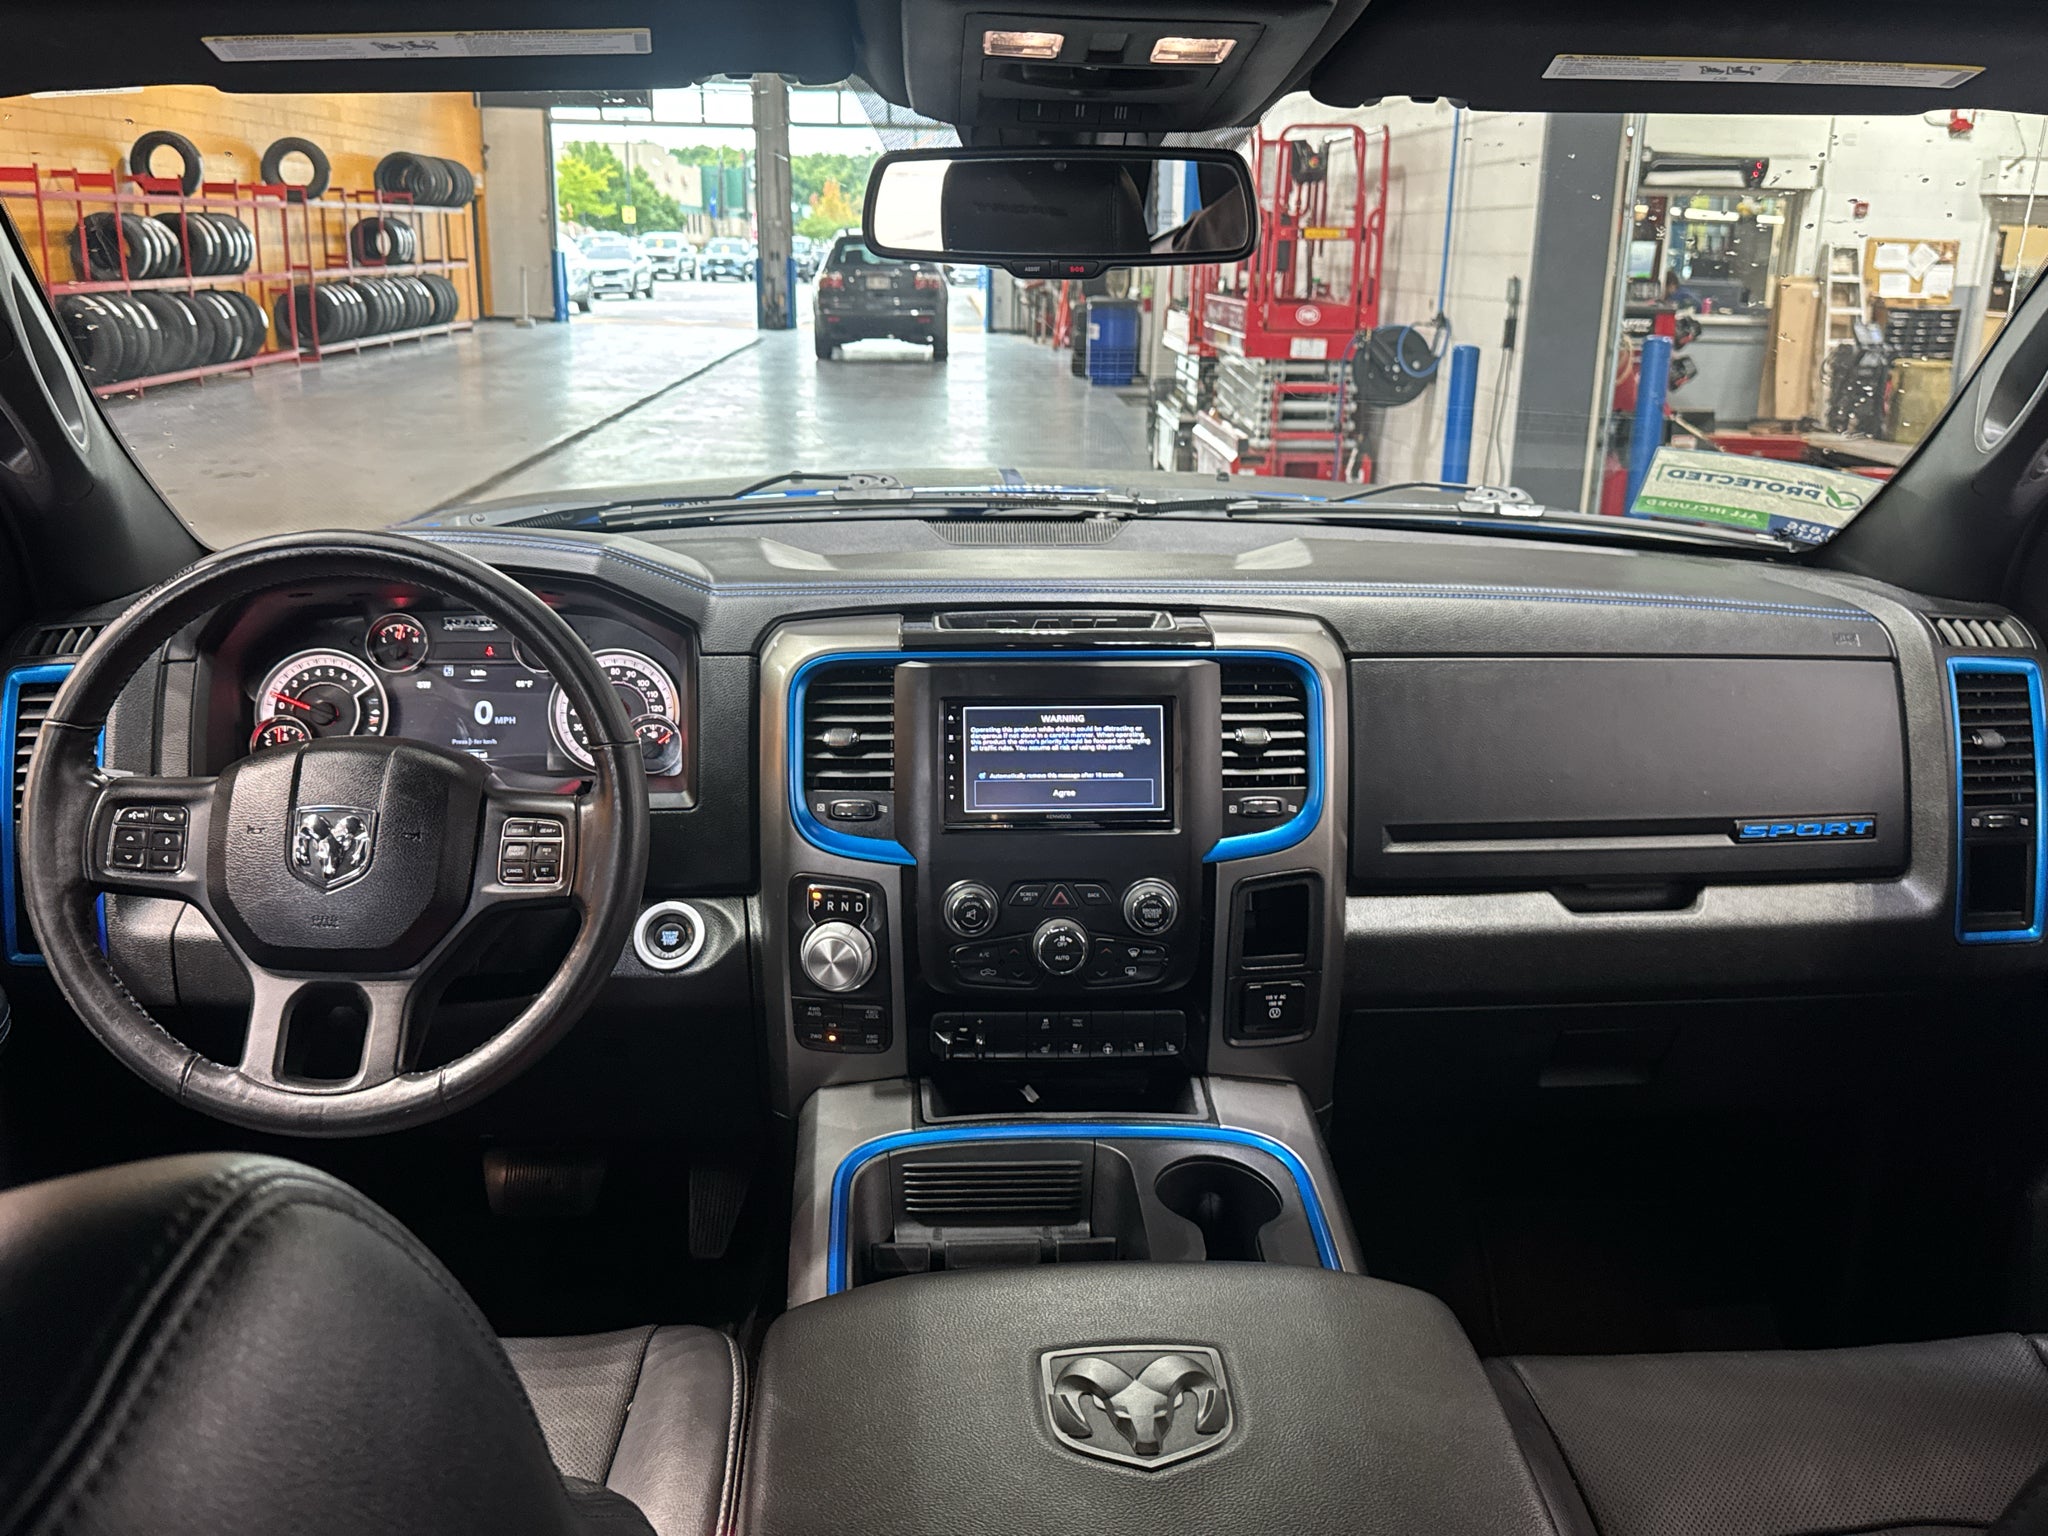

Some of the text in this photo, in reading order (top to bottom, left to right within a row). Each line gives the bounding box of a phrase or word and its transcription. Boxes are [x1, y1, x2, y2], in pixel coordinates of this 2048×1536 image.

[328, 669, 335, 677] 5
[611, 667, 621, 676] 80
[626, 670, 637, 678] 90
[303, 673, 309, 681] 3
[341, 673, 348, 681] 6
[292, 680, 299, 688] 2
[637, 679, 650, 687] 100
[651, 704, 663, 712] 120
[474, 700, 516, 725] 0 MPH
[1040, 714, 1085, 723] WARNING
[1055, 725, 1076, 733] driving
[1103, 725, 1134, 733] distracting
[1078, 744, 1095, 752] using
[989, 772, 1026, 780] Automatically
[1052, 789, 1077, 799] Agree
[1739, 821, 1874, 838] SPORT
[813, 902, 864, 913] P R N D
